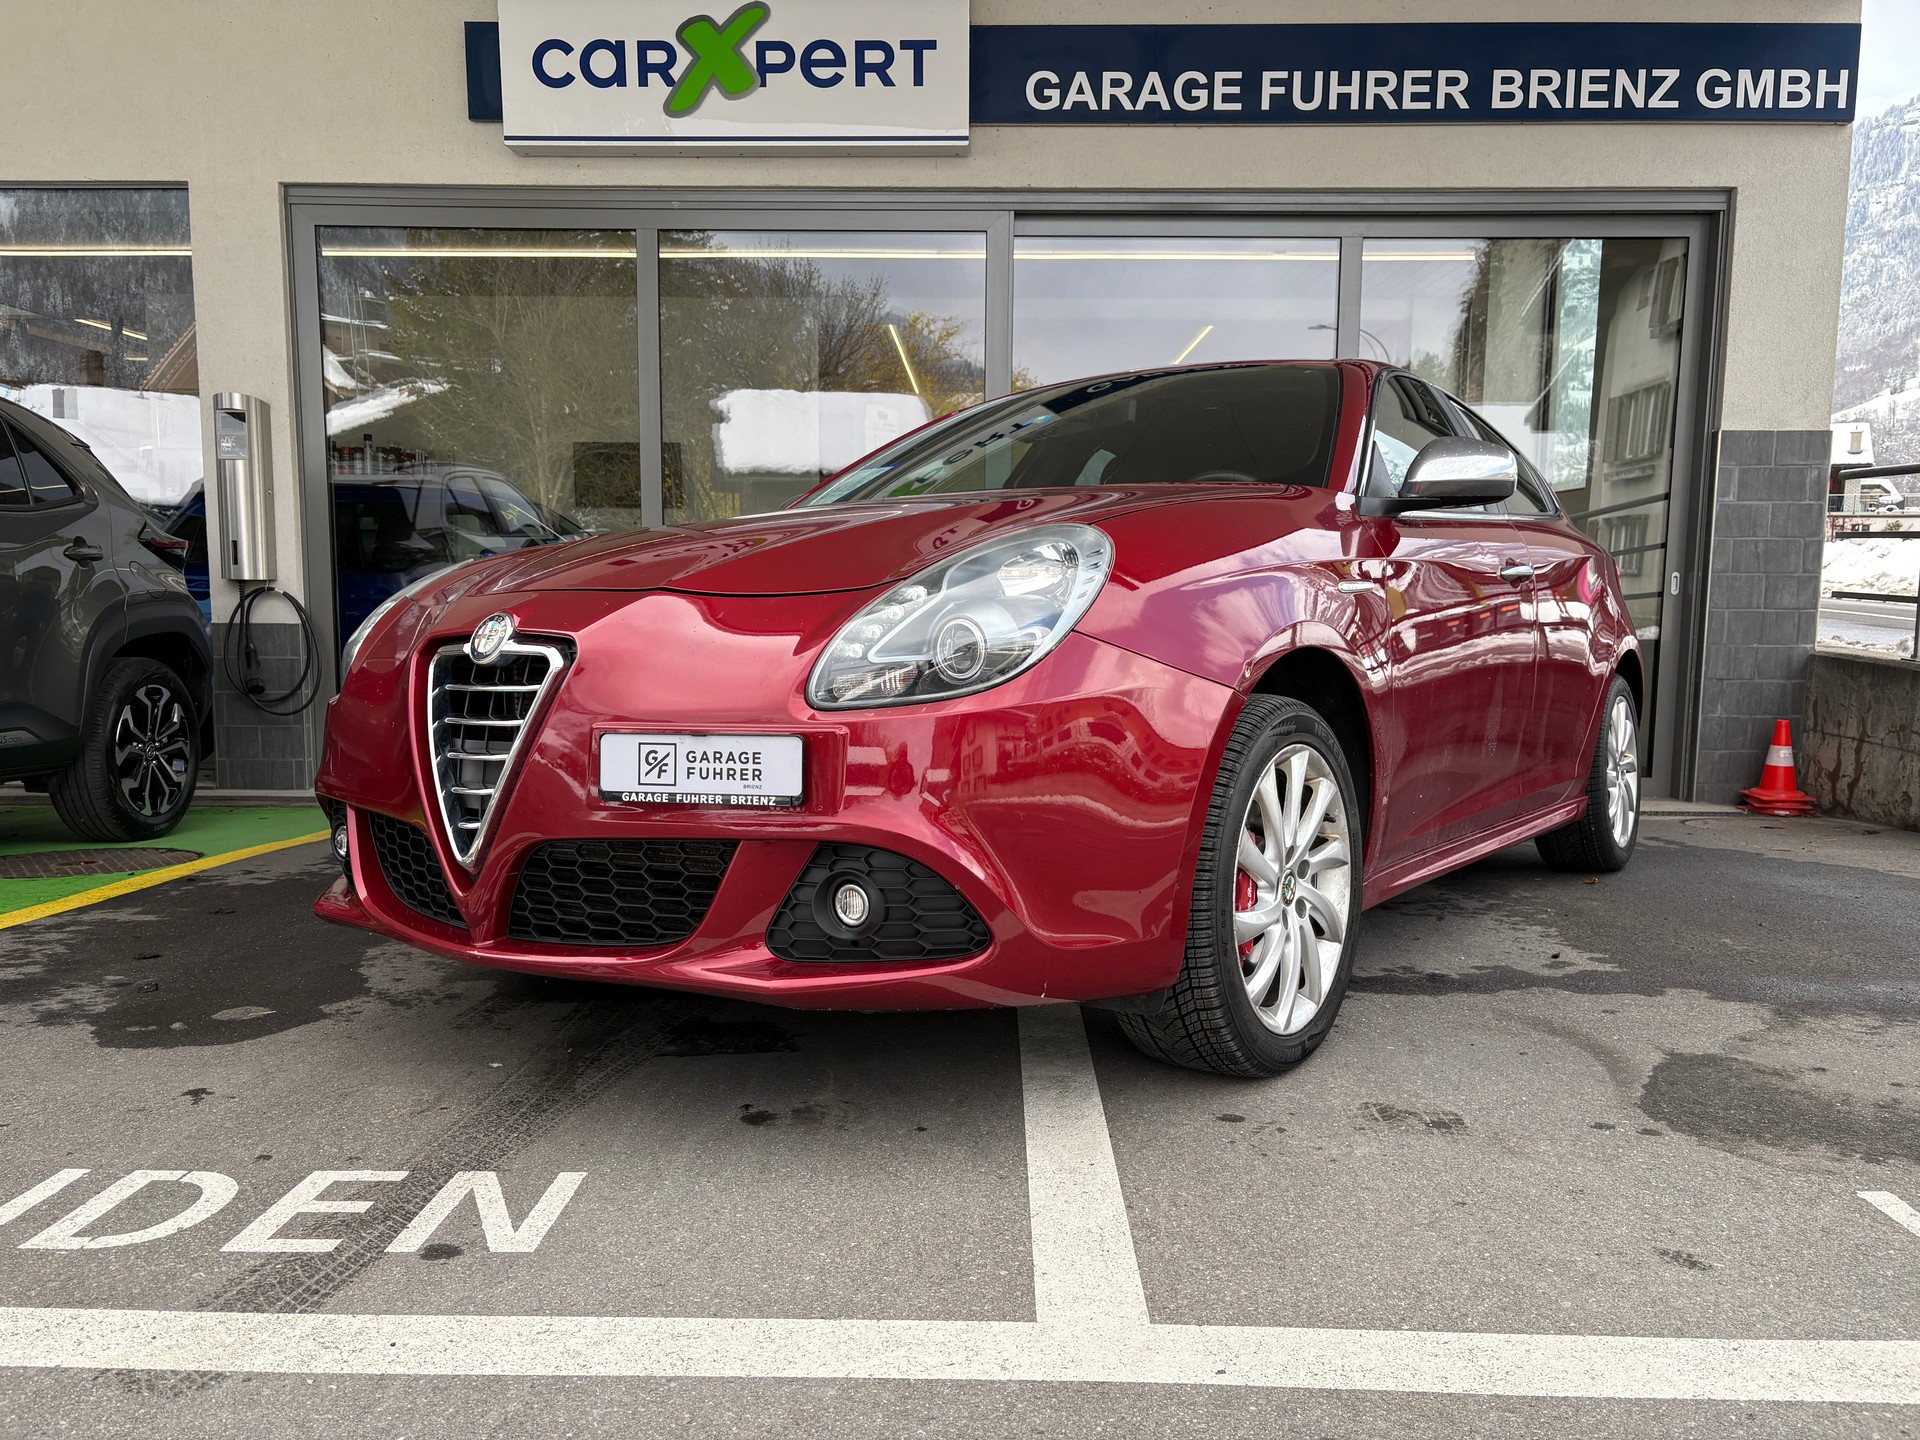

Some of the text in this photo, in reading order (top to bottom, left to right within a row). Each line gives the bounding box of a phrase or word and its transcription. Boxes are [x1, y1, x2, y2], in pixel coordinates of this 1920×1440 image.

[1025, 68, 1849, 111] GARAGE FUHRER BRIENZ GMBH
[685, 750, 762, 765] GARAGE
[686, 766, 763, 782] FUHRER
[621, 792, 776, 806] GARAGE FUHRER BRIENZ
